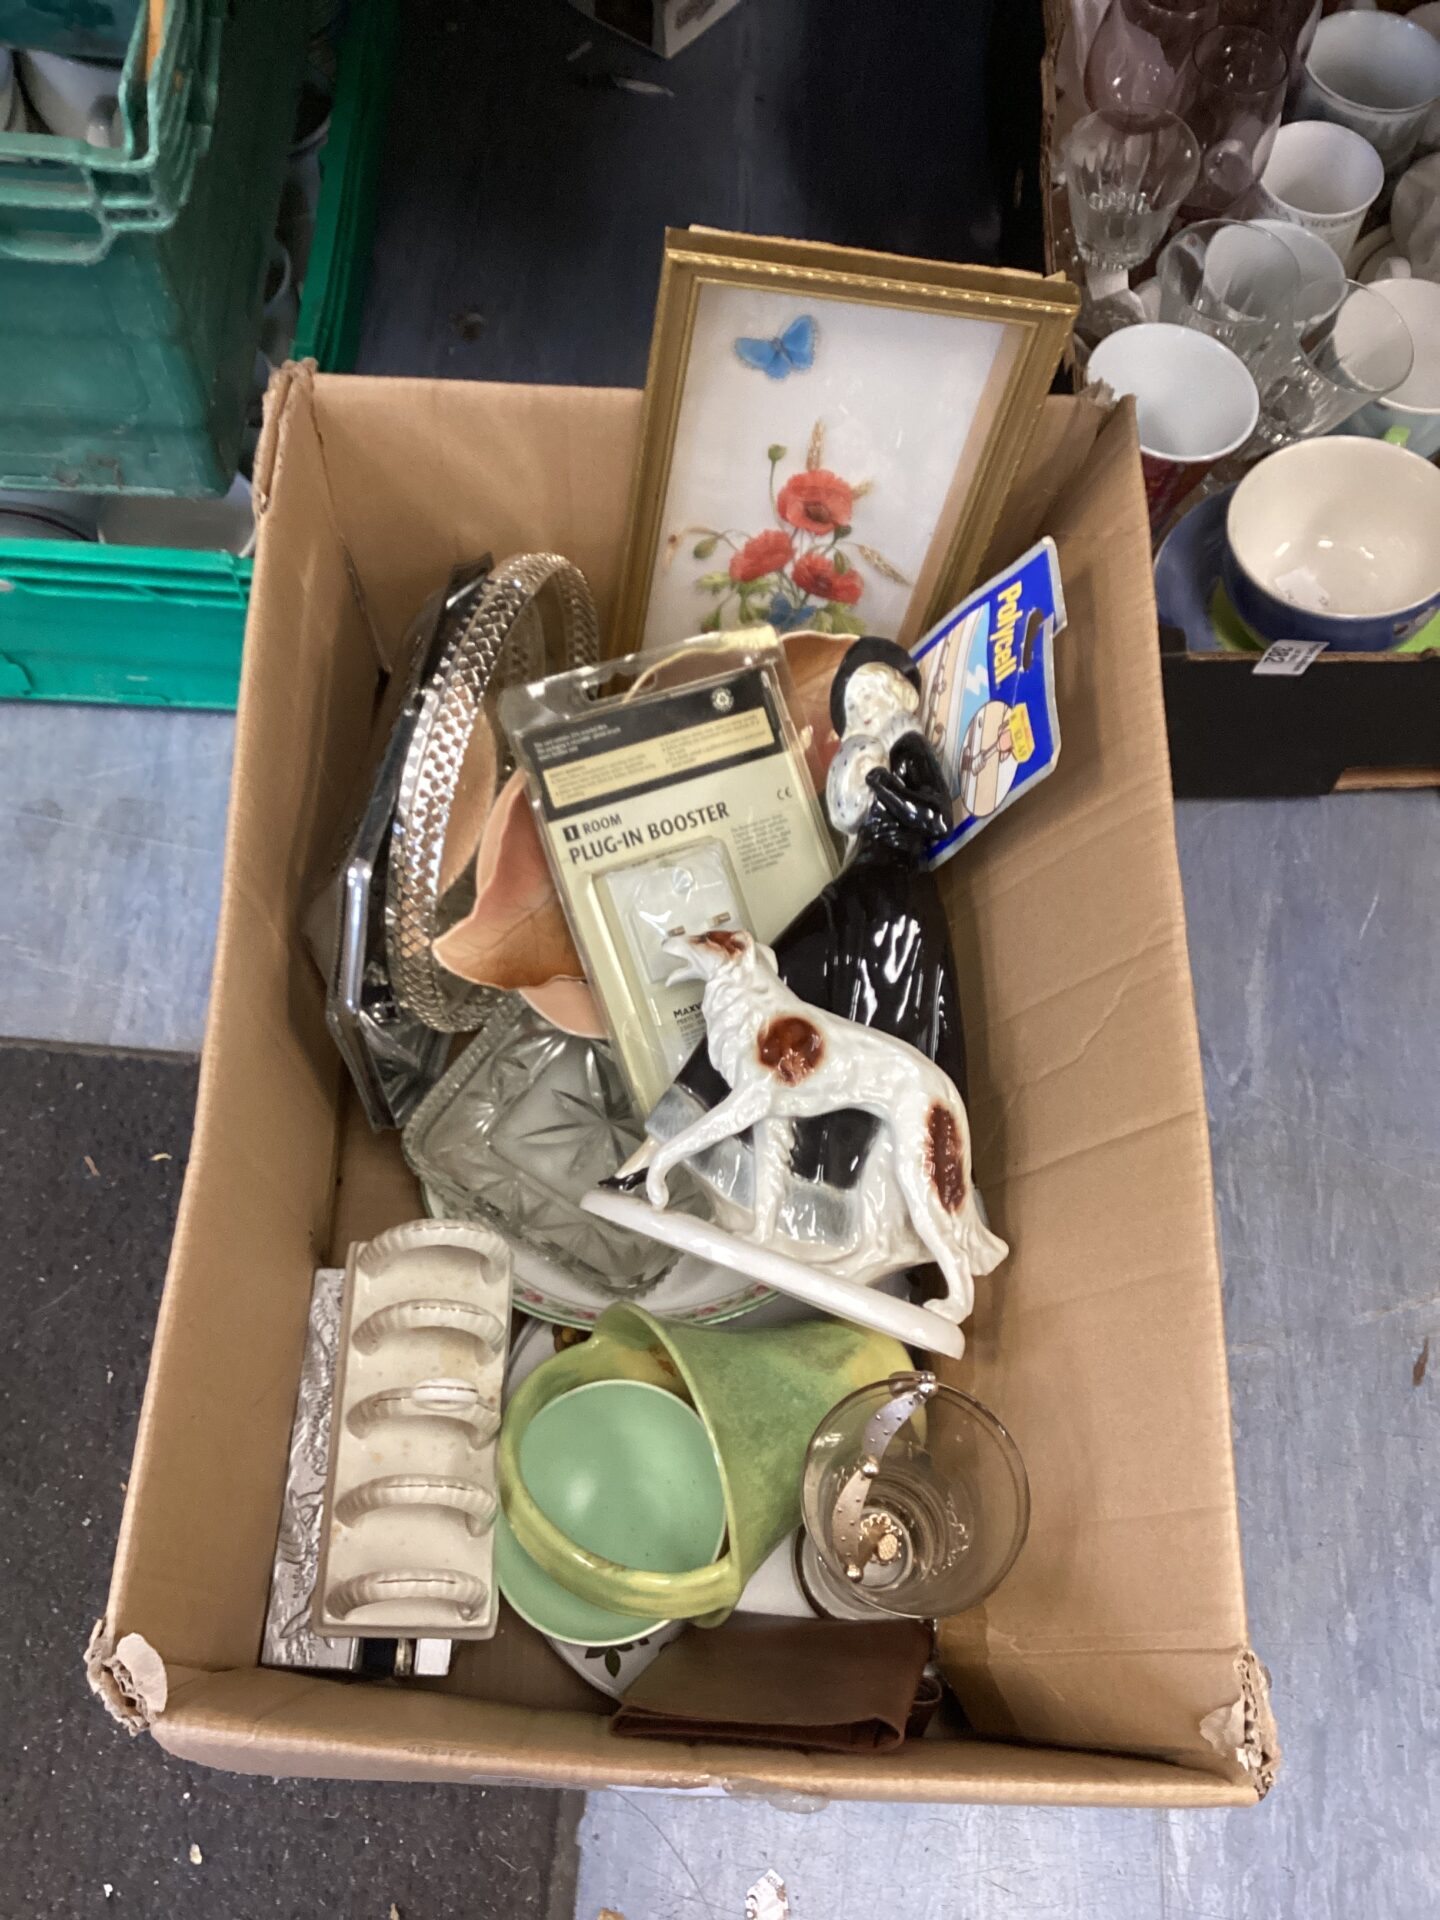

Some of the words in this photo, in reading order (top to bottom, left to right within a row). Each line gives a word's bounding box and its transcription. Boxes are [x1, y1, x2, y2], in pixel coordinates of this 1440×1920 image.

[989, 579, 1023, 685] Polycell
[569, 827, 645, 865] PLUG-IN
[647, 801, 730, 841] BOOSTER
[582, 813, 622, 835] ROOM
